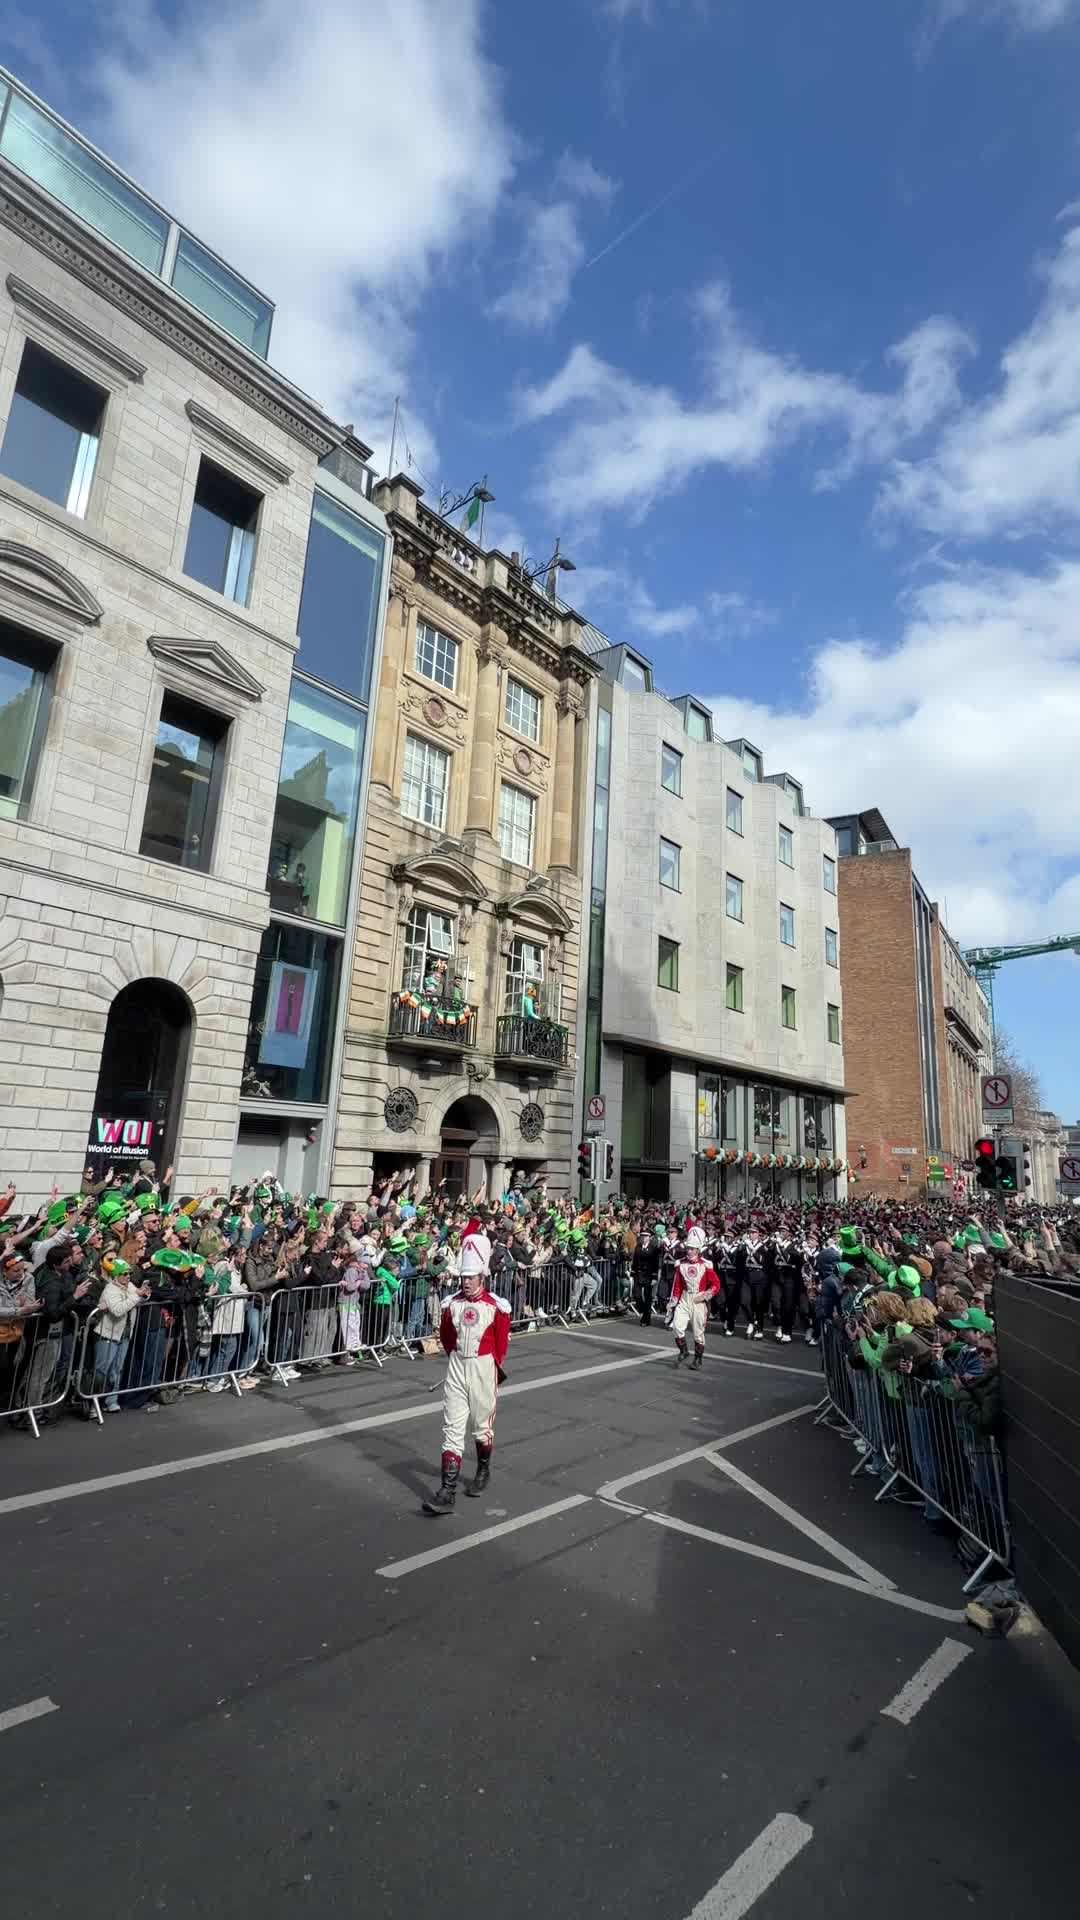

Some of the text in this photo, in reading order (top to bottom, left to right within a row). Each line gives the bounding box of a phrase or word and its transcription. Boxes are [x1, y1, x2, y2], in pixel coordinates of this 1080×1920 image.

[97, 1118, 152, 1145] WOI
[88, 1145, 149, 1155] World of Illusion
